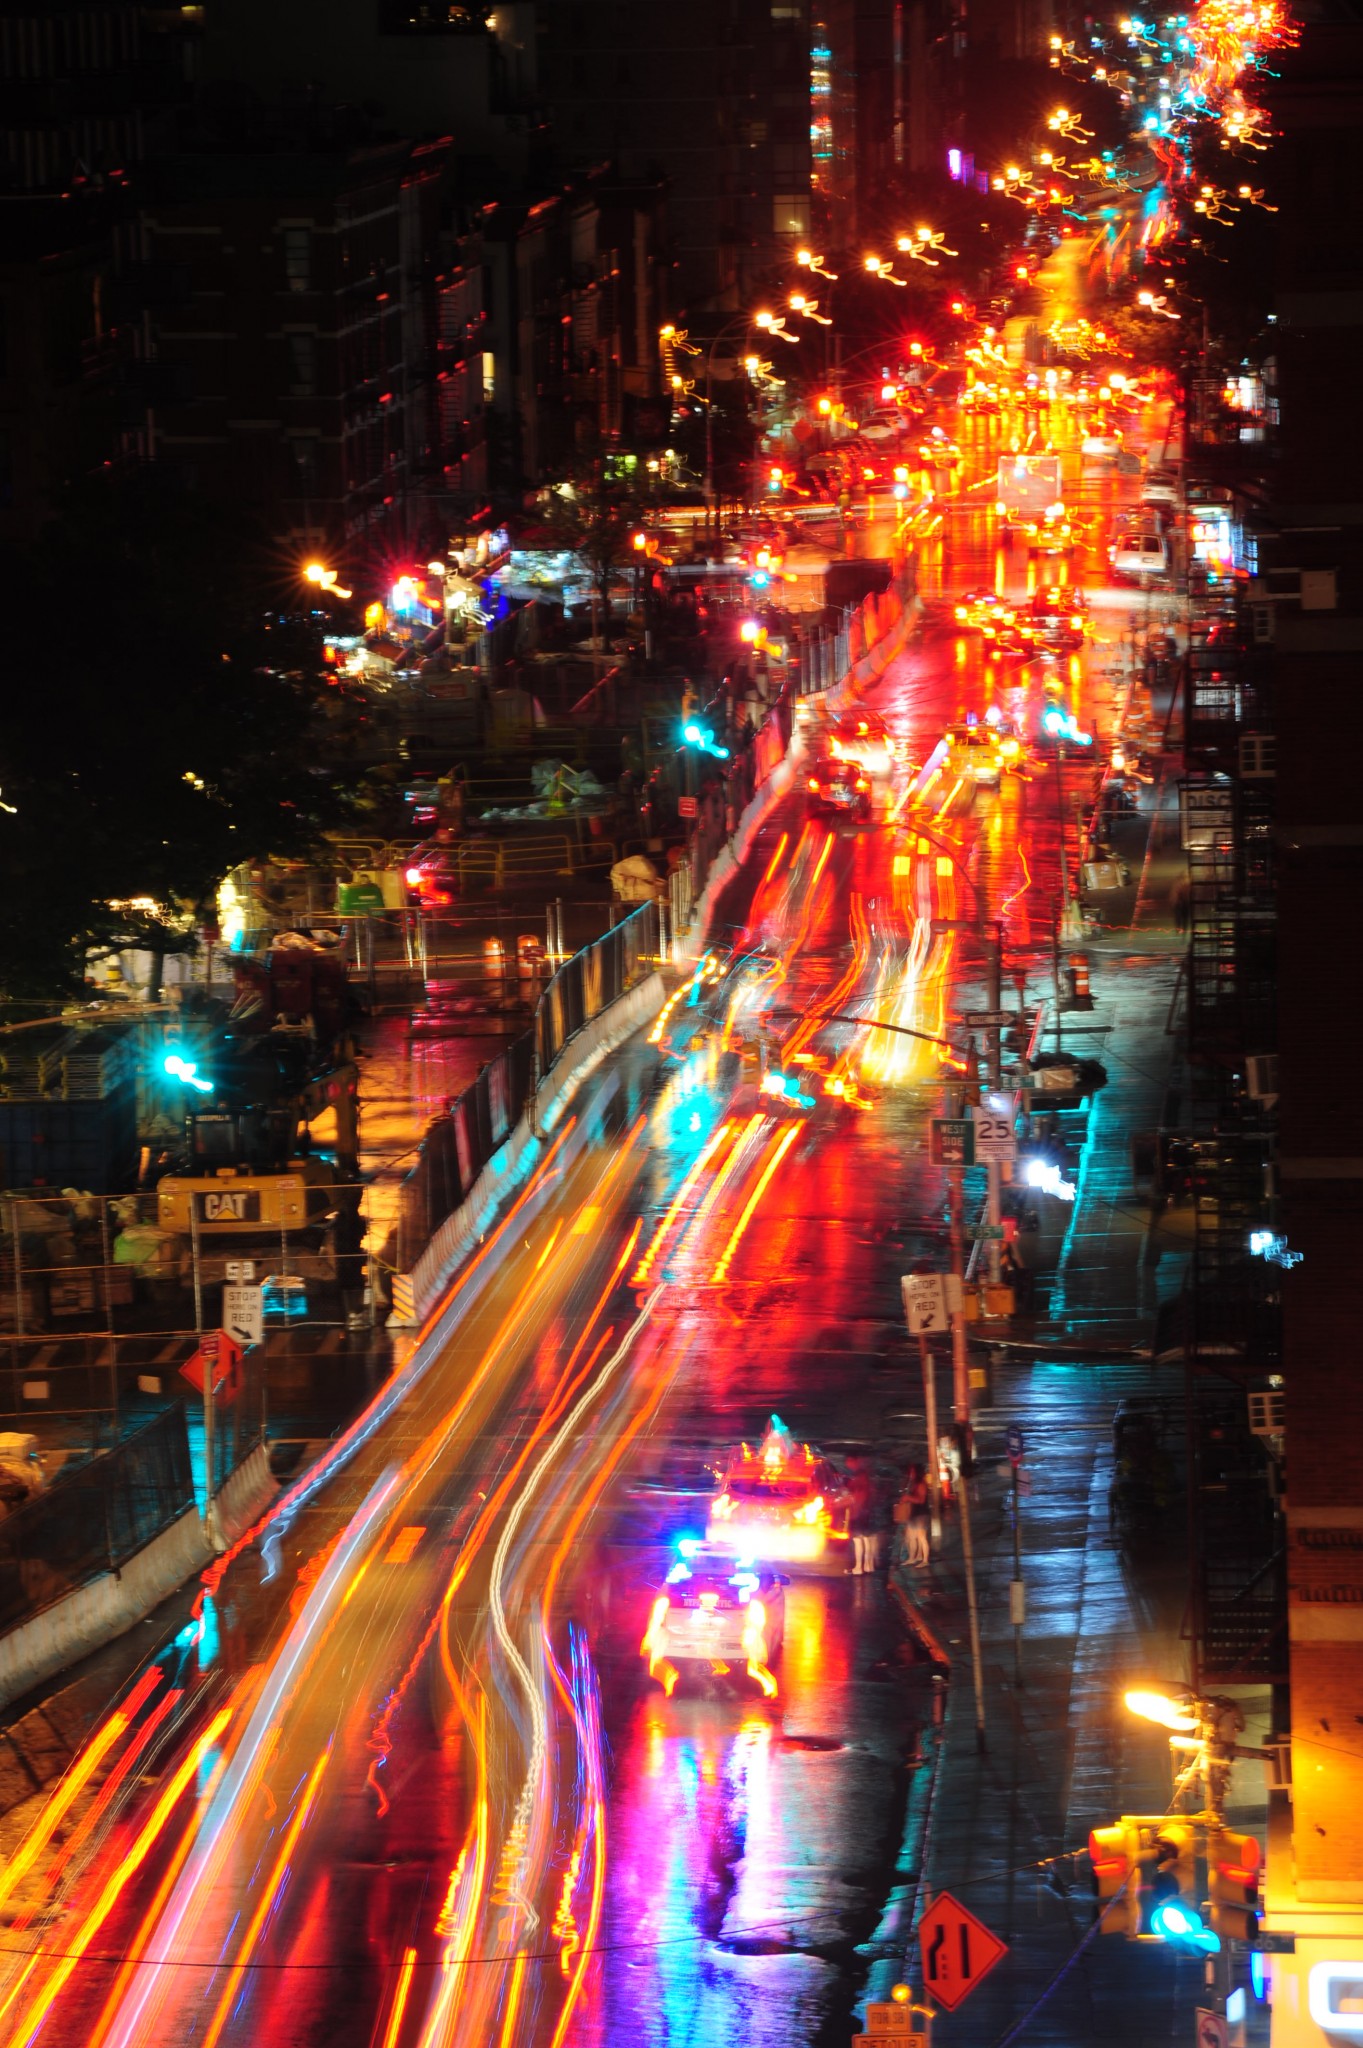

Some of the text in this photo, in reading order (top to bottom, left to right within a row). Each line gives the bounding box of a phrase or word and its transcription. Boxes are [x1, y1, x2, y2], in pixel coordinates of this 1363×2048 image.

[940, 1125, 965, 1134] WEST
[978, 1120, 1010, 1139] 25
[942, 1137, 964, 1146] SIDE
[204, 1193, 247, 1219] CAT
[967, 1227, 973, 1238] E
[976, 1227, 991, 1238] 85
[911, 1280, 935, 1290] STOP
[228, 1292, 257, 1301] STOP
[915, 1301, 936, 1311] RED
[231, 1313, 252, 1322] RED
[871, 2012, 889, 2024] FOR
